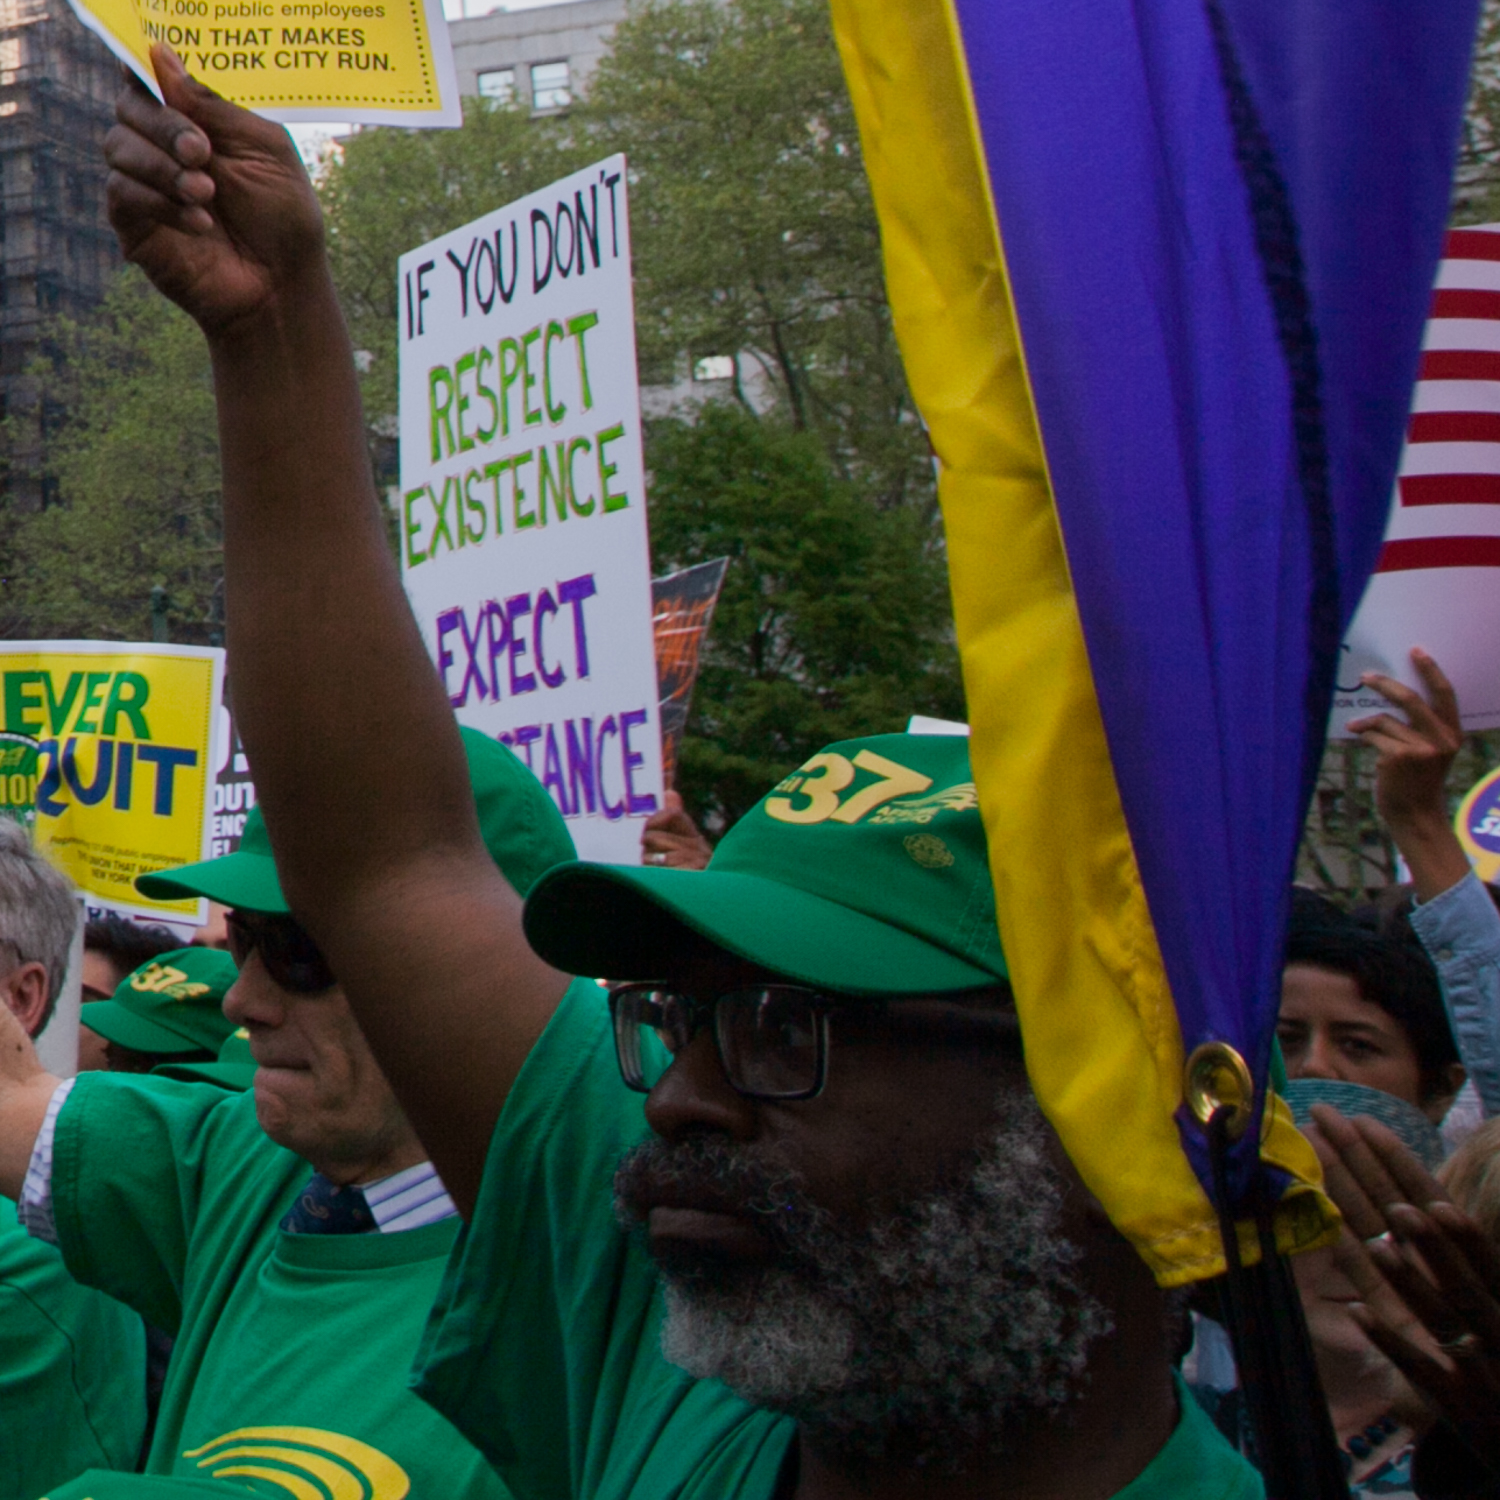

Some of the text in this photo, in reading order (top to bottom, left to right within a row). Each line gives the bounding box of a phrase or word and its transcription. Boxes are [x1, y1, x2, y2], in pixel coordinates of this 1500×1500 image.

[208, 27, 272, 47] THAT
[281, 27, 366, 48] MAKES
[214, 1, 274, 21] public
[280, 1, 386, 21] employees
[196, 50, 265, 72] YORK
[273, 50, 330, 70] CITY
[337, 51, 397, 73] RUN.
[404, 169, 623, 341] IF YOU DON'T
[427, 308, 599, 465] RESPECT
[403, 420, 632, 569] EXISTENCE
[435, 573, 598, 709] EXPECT
[37, 736, 198, 818] QUIT
[499, 708, 659, 821] TANCE
[764, 748, 934, 826] 37
[129, 961, 189, 994] 37
